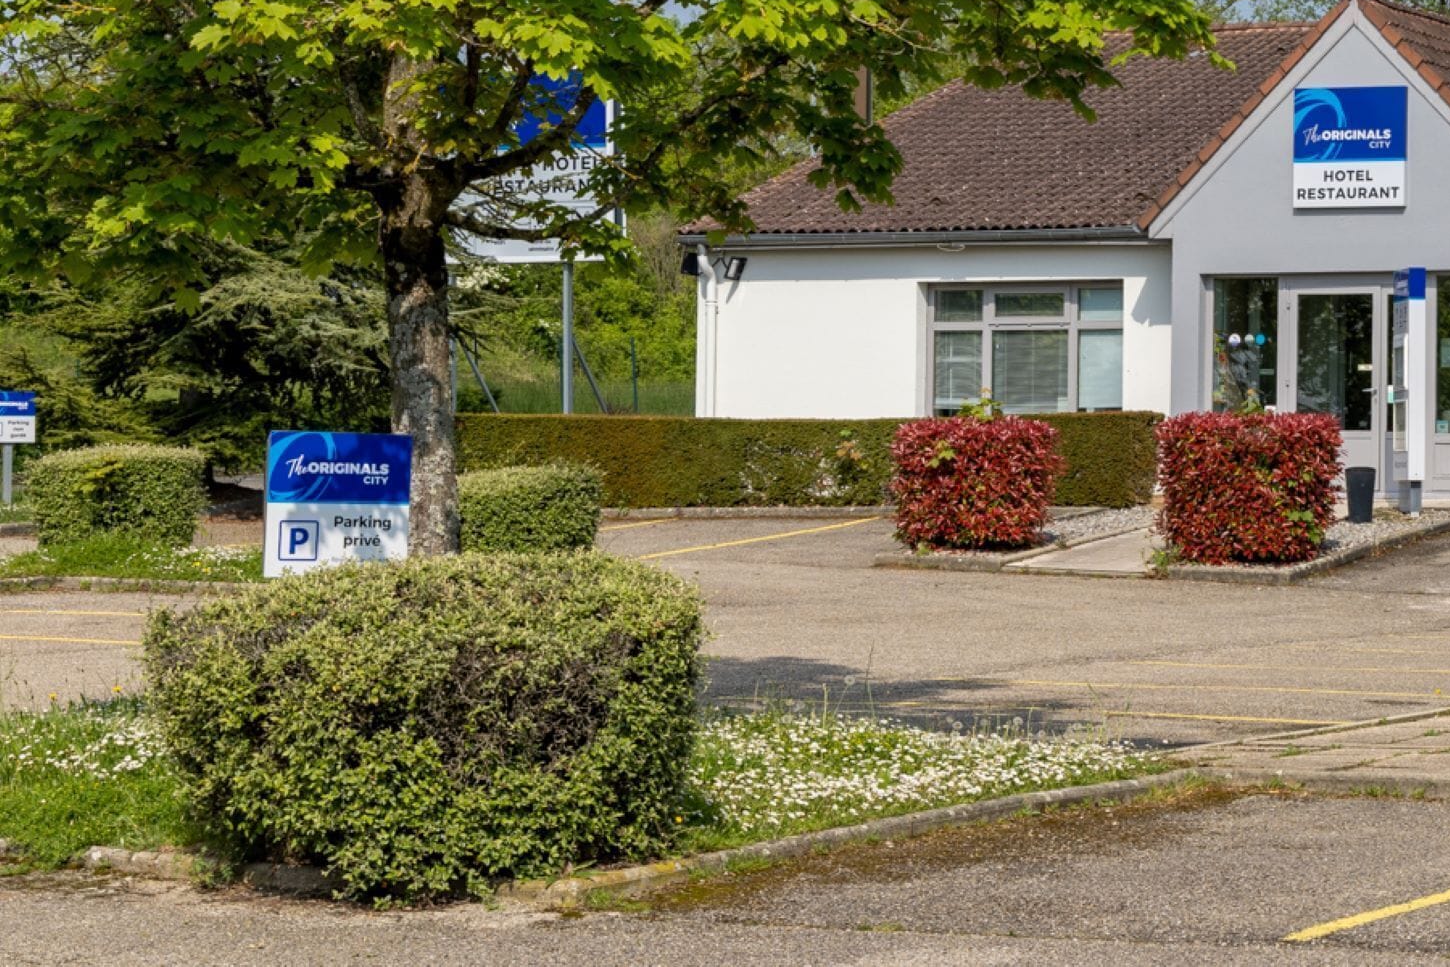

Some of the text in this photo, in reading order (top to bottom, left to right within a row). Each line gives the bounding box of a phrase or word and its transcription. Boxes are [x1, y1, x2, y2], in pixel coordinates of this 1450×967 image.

[1303, 124, 1391, 146] The ORIGINALS
[1368, 141, 1391, 149] CITY
[1323, 170, 1373, 183] HOTEL
[487, 178, 592, 194] ESTAURAN
[1297, 186, 1400, 200] RESTAURANT
[285, 453, 390, 479] The ORIGINALS
[363, 475, 389, 485] CITY
[333, 515, 392, 531] Parking
[289, 527, 310, 555] P
[343, 533, 381, 548] privé
